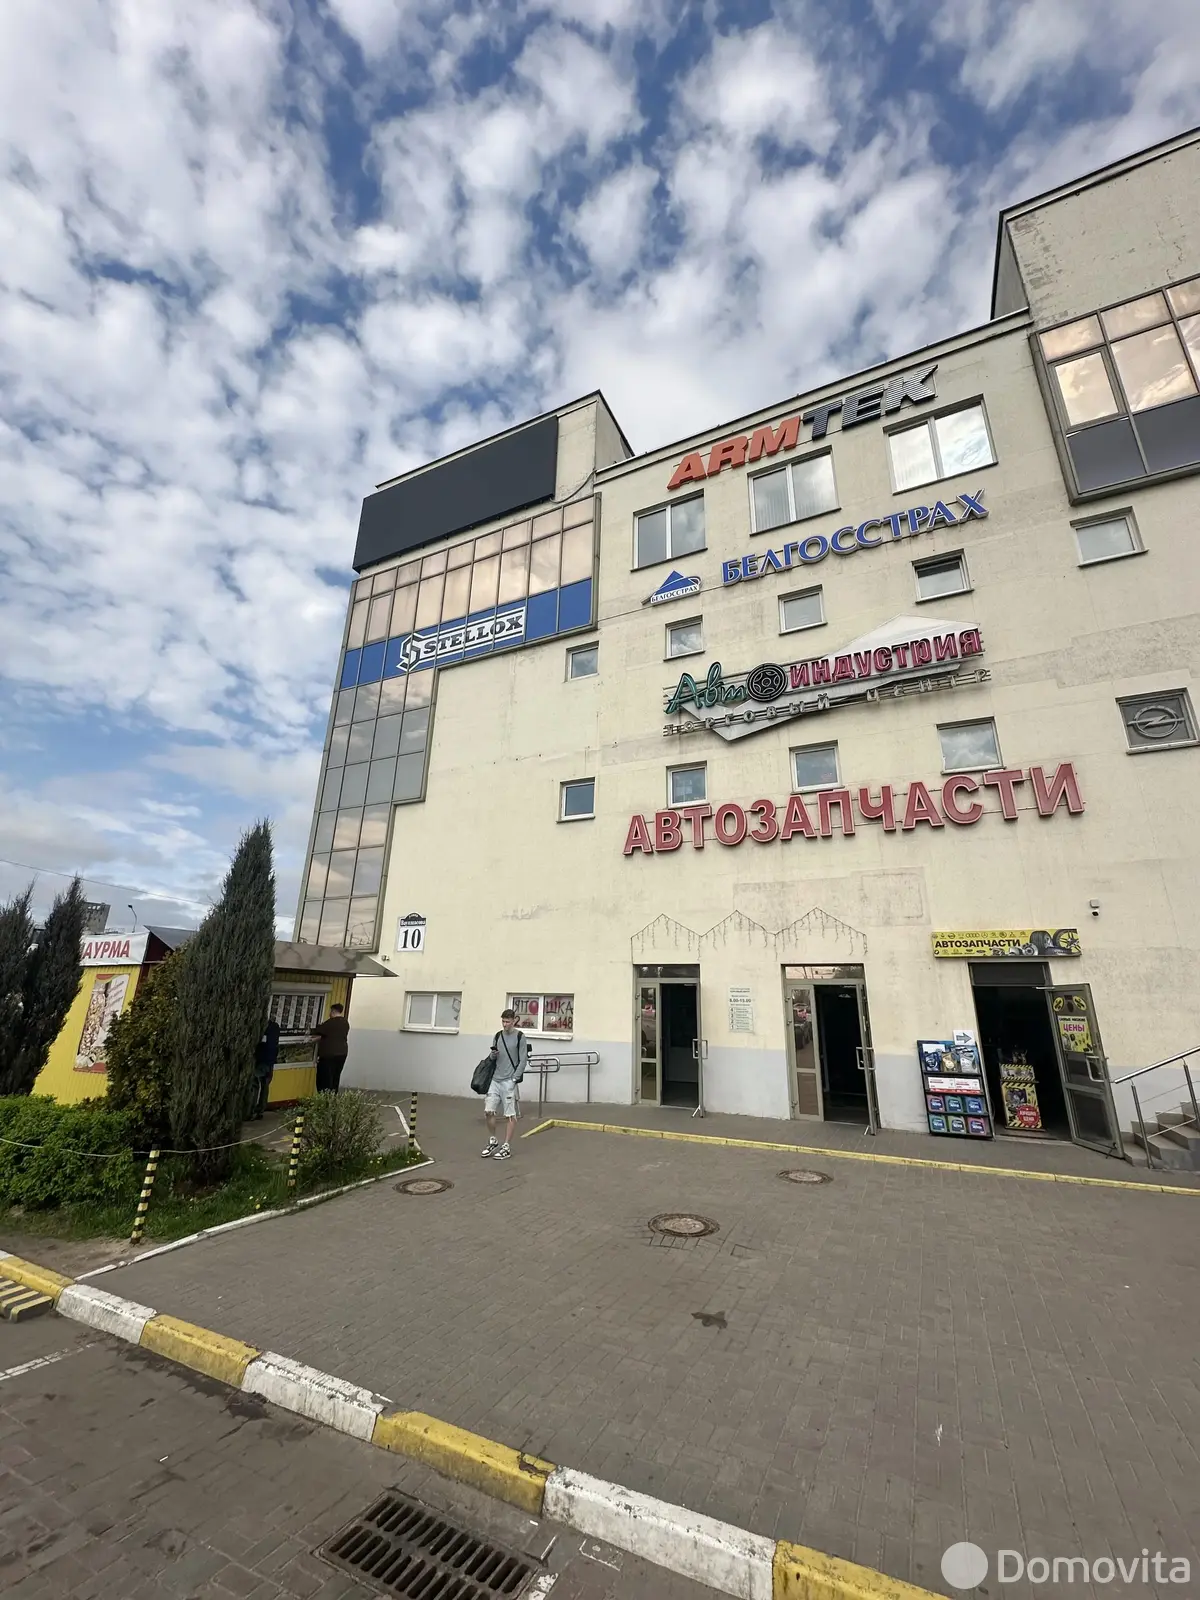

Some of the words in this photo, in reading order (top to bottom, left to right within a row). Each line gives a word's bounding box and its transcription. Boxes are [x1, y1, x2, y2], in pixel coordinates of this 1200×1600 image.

[667, 364, 938, 490] ARMTEK
[721, 488, 989, 586] БЕЛГОССТРАХ
[651, 585, 698, 603] БЕЛГОССТРАХ
[423, 614, 523, 655] STELLOX
[623, 762, 1085, 855] АВТОЗАПЧАСТИ
[81, 939, 130, 959] АУРМА
[401, 928, 422, 949] 10
[934, 939, 1021, 949] АВТОЗАПЧАСТИ
[1063, 1023, 1085, 1032] ЦЕНЫ
